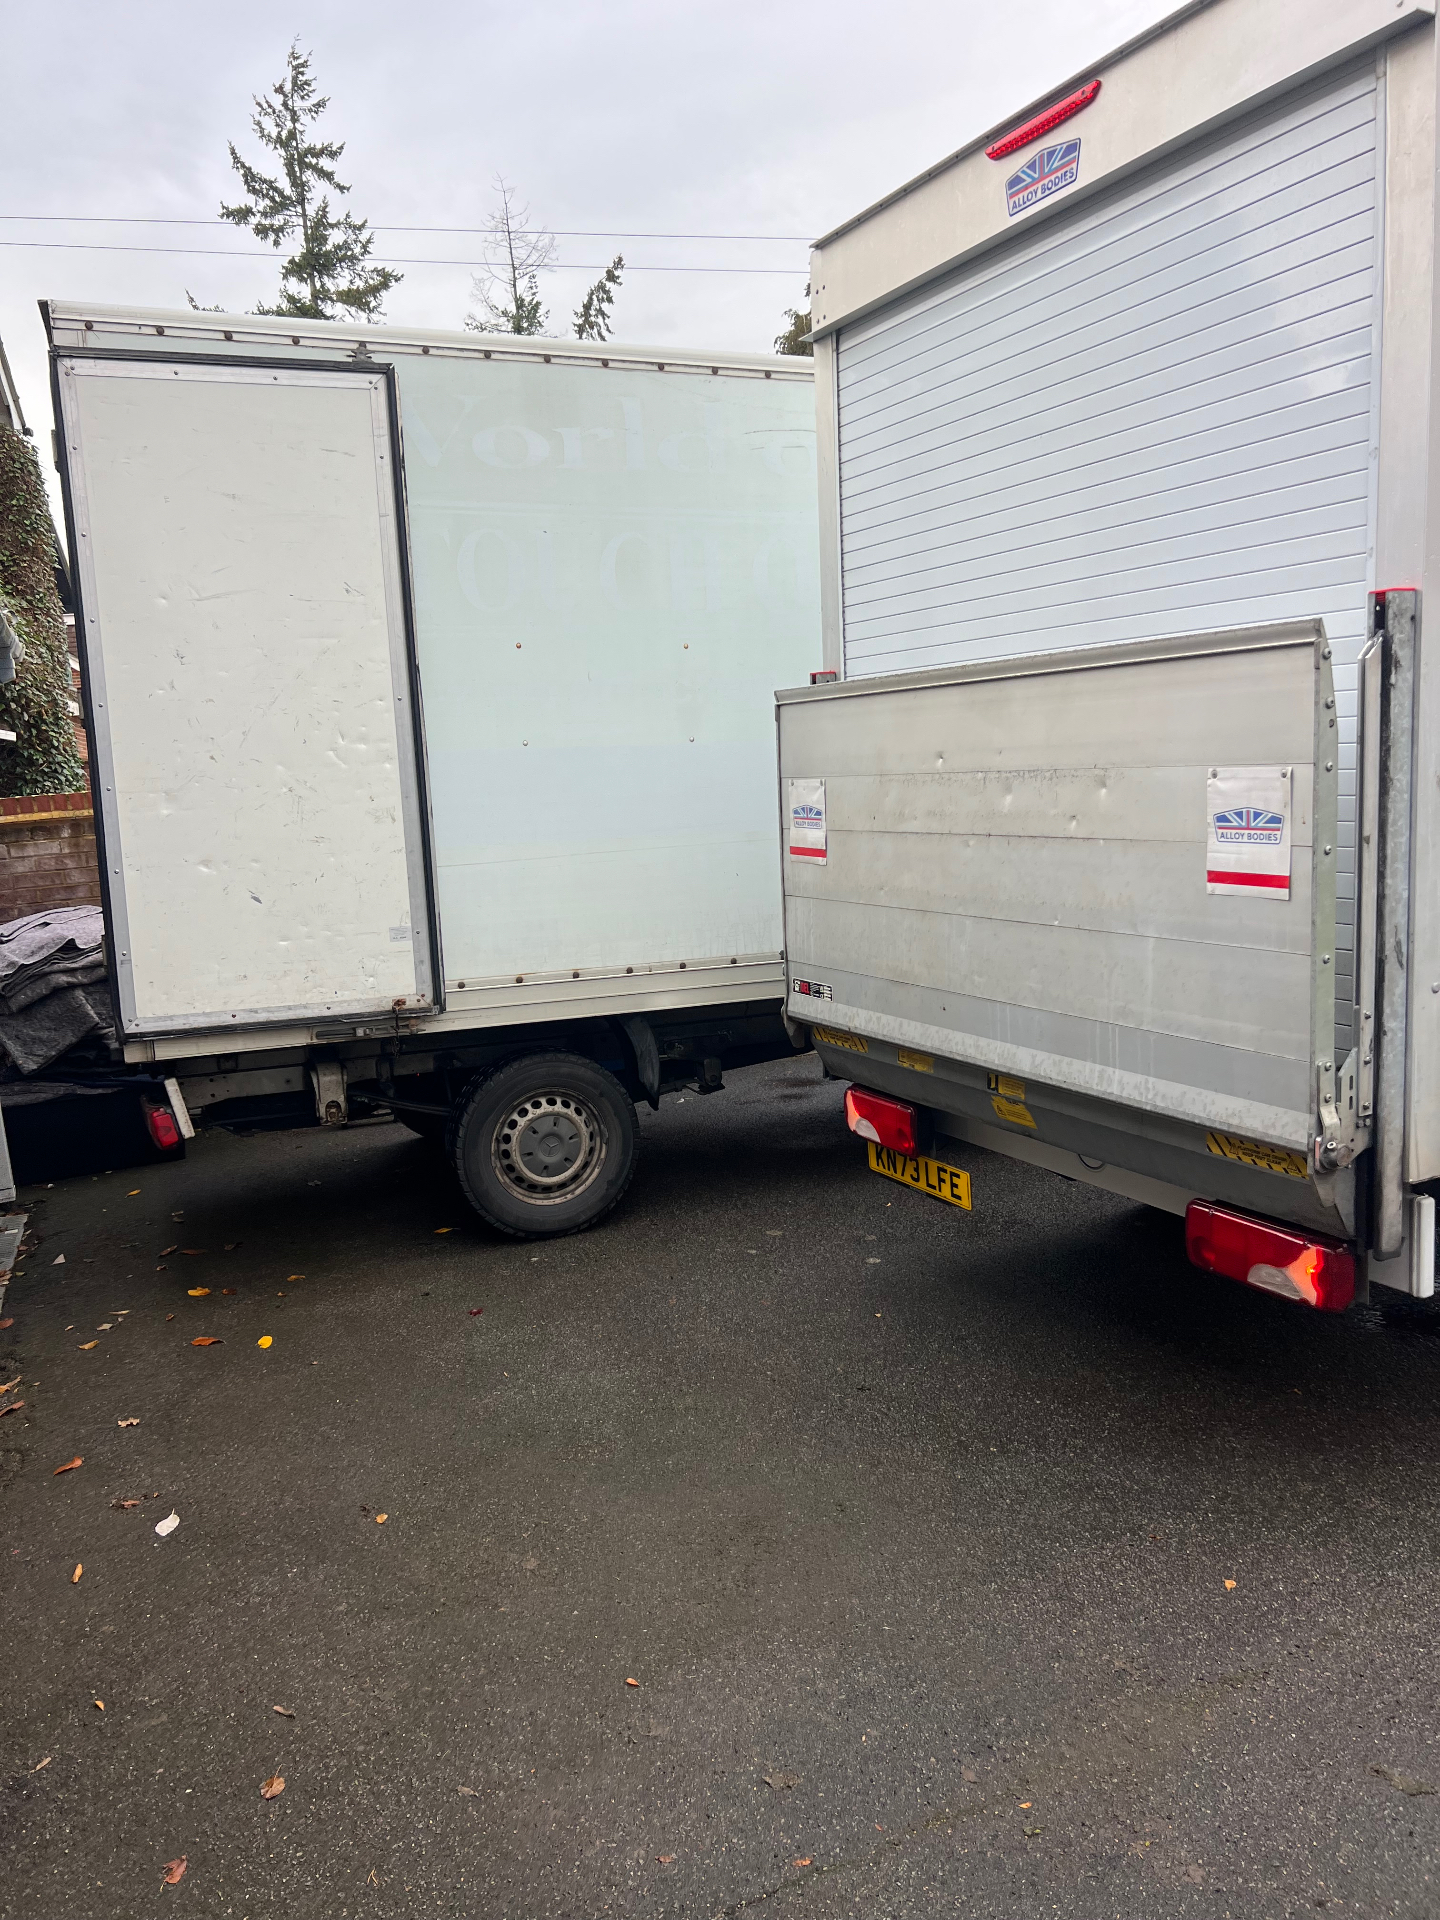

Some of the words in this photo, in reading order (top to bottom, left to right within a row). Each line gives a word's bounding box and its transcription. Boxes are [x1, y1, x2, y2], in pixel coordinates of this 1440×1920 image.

[1011, 189, 1039, 212] ALLOY
[1040, 167, 1075, 195] BODIES
[1219, 831, 1246, 840] ALLOY
[1246, 832, 1278, 842] BODIES
[875, 1143, 920, 1184] KN73
[924, 1160, 962, 1202] LFE
